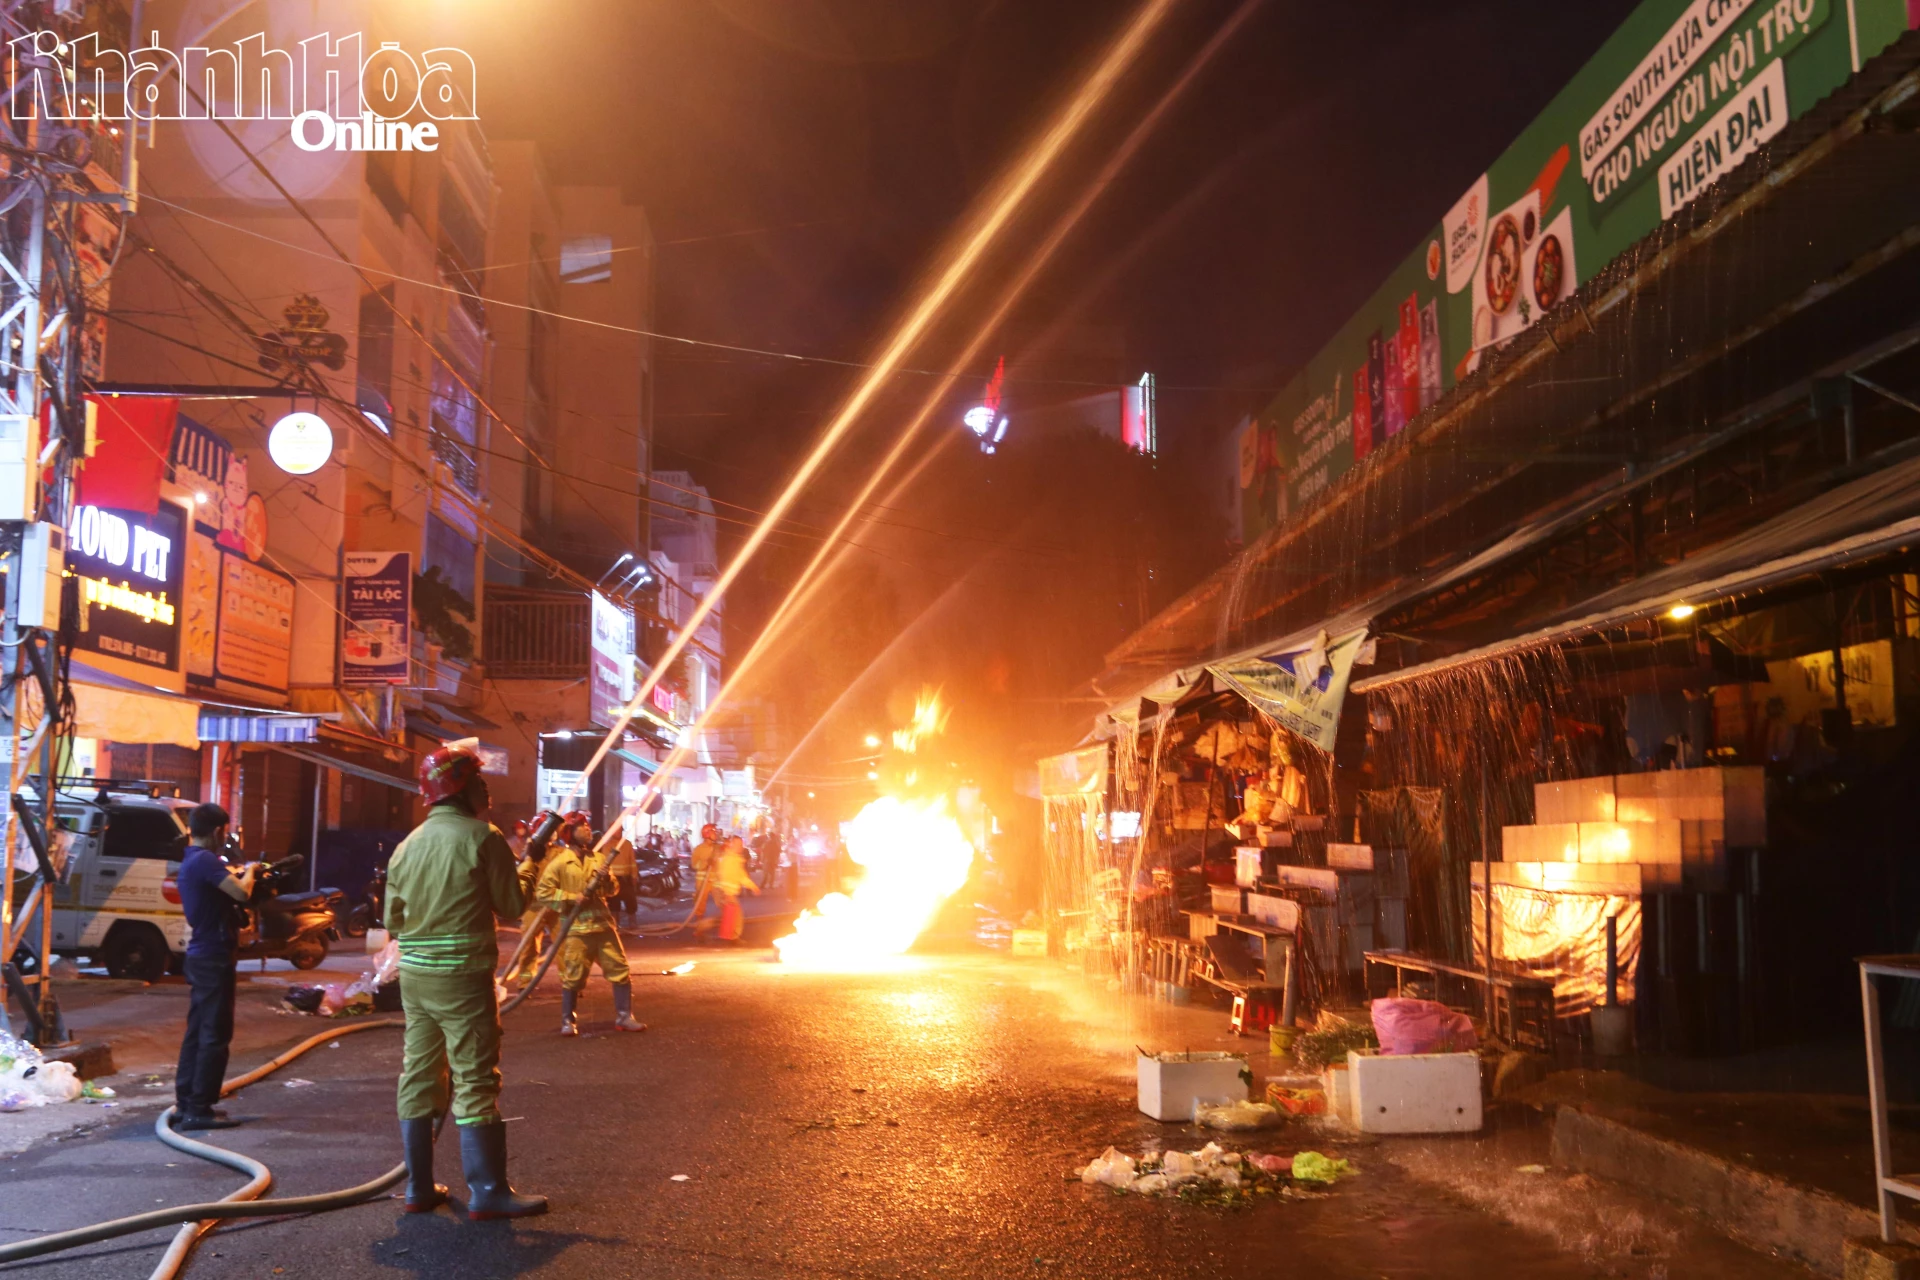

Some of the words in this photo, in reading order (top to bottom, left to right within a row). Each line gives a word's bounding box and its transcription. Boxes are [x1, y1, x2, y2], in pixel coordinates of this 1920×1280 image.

[1583, 114, 1612, 162] GAS
[1613, 54, 1665, 131] SOUTH
[1668, 15, 1703, 71] LỰA
[1593, 145, 1632, 203] CHO
[1635, 73, 1706, 168] NGƯỜI
[1709, 29, 1755, 100] NỘI
[1727, 85, 1772, 155] ĐẠI
[132, 524, 171, 582] PET
[352, 587, 373, 600] TÀI
[375, 587, 402, 603] LỘC
